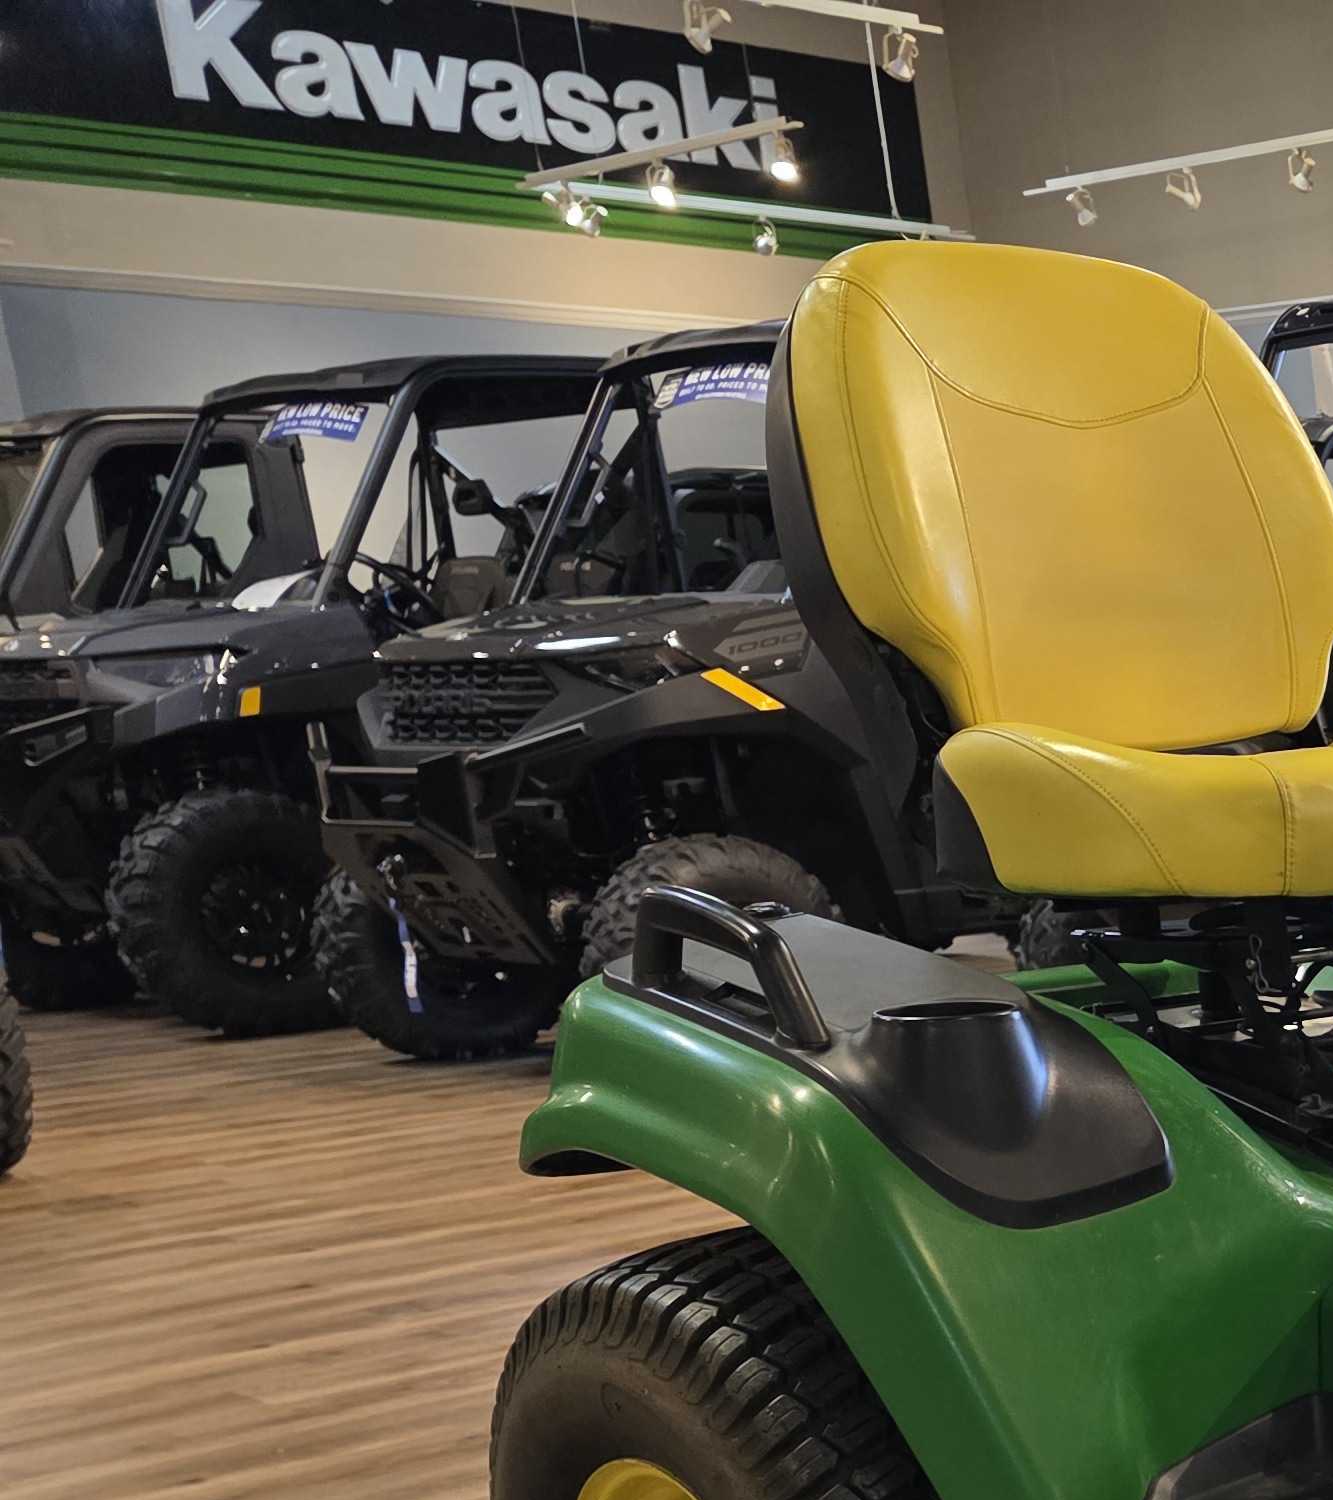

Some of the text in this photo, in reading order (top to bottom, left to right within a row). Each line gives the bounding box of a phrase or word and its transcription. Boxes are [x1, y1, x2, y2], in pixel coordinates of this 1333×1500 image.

[157, 0, 778, 172] Kawasaki
[712, 362, 745, 380] LOW
[744, 362, 771, 380] PRI
[321, 402, 365, 423] PRICE
